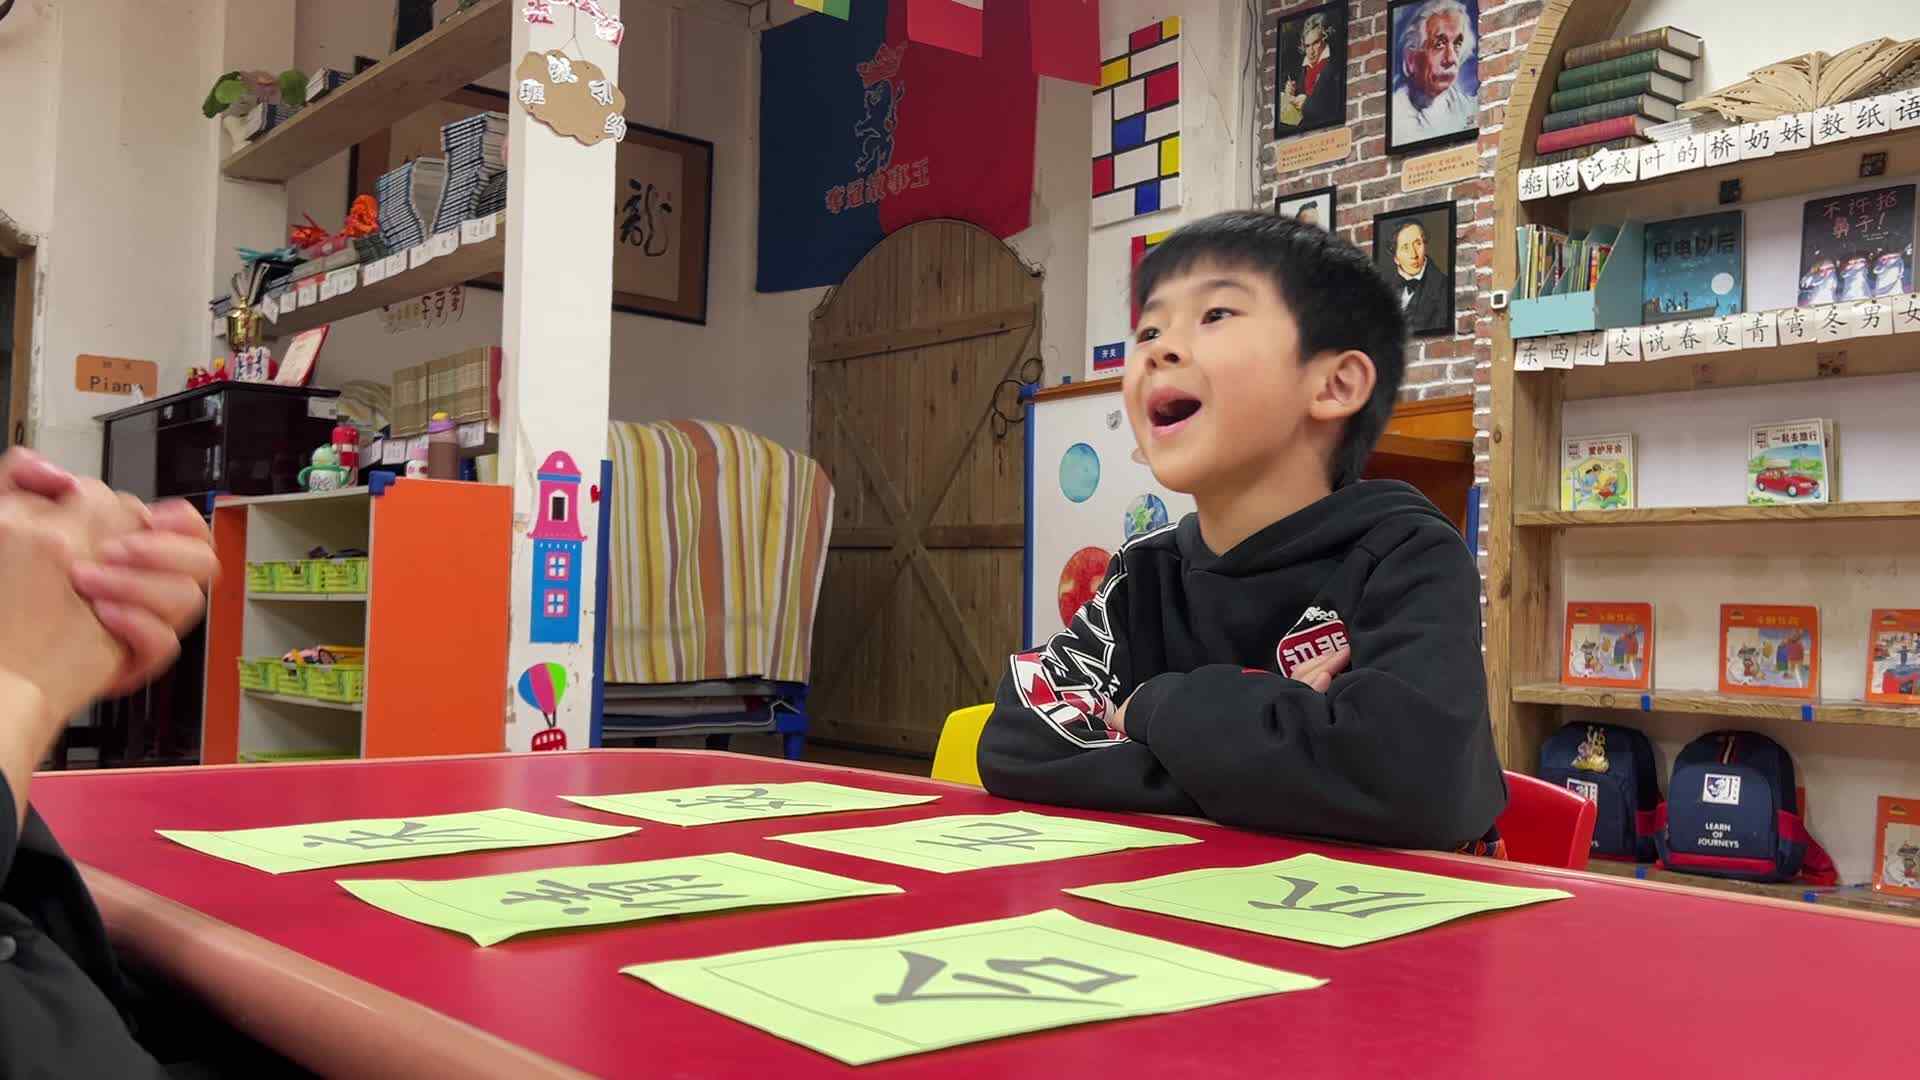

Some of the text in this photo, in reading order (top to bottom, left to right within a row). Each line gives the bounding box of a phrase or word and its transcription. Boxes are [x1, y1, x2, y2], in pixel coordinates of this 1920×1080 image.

[1522, 97, 1920, 195] 船 说 江 秋 叶 的 桥 奶 妹 数 纸 语
[1522, 343, 1539, 366] 东
[1550, 343, 1569, 362] 西
[1580, 337, 1600, 357] 北
[1615, 333, 1633, 356] 尖
[1647, 331, 1671, 352] 说
[1679, 327, 1702, 349] 春
[1712, 322, 1735, 346] 夏
[1746, 317, 1769, 343] 青
[1822, 308, 1848, 334] 冬
[1861, 305, 1882, 329] 男
[1898, 300, 1920, 323] 女
[1697, 838, 1739, 849] JOURNEYS
[1705, 822, 1731, 832] LEARN
[1712, 830, 1723, 838] OF
[500, 875, 749, 915] 请
[1248, 874, 1482, 919] 瓜
[873, 949, 1140, 1007] 合
